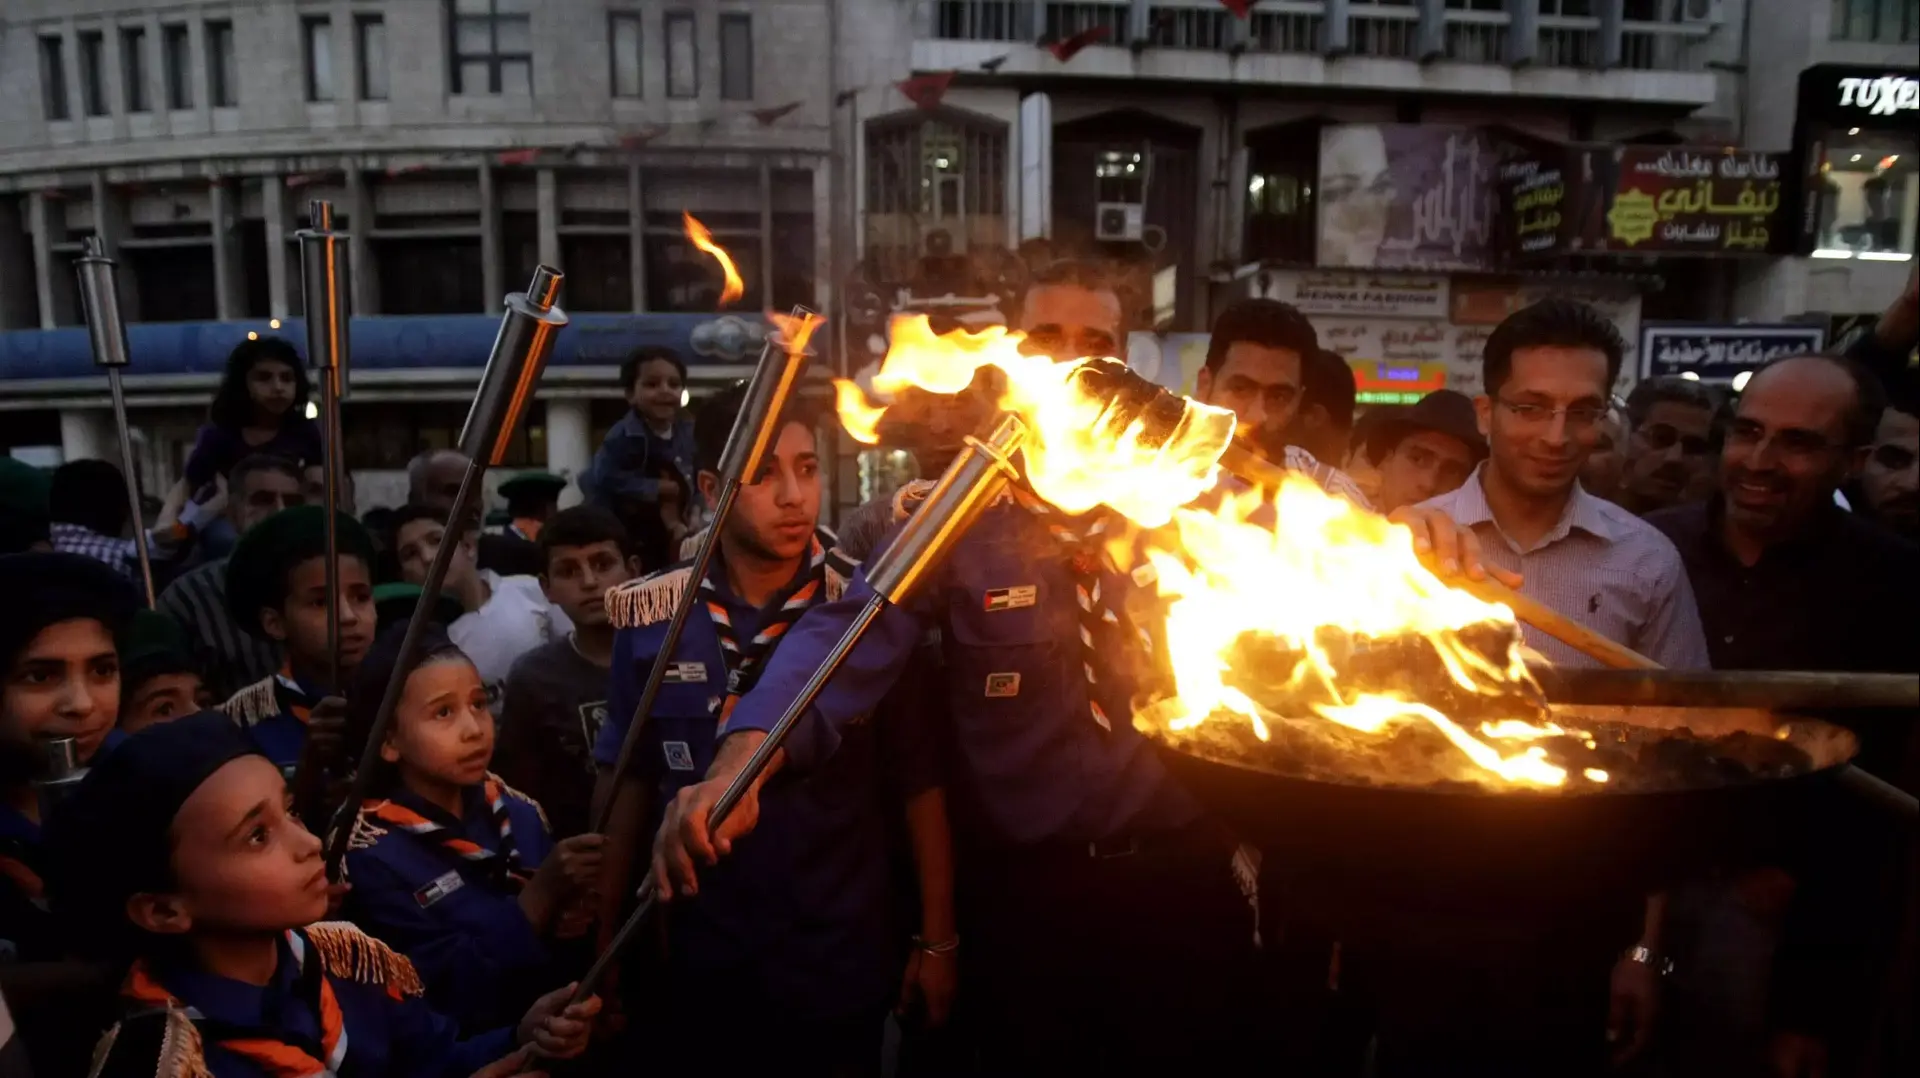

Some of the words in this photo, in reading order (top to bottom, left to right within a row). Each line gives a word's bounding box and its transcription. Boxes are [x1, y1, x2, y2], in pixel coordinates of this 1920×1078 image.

[1657, 179, 1781, 222] تيفاني
[1724, 220, 1769, 249] جينز
[1657, 336, 1726, 372] للأحذية
